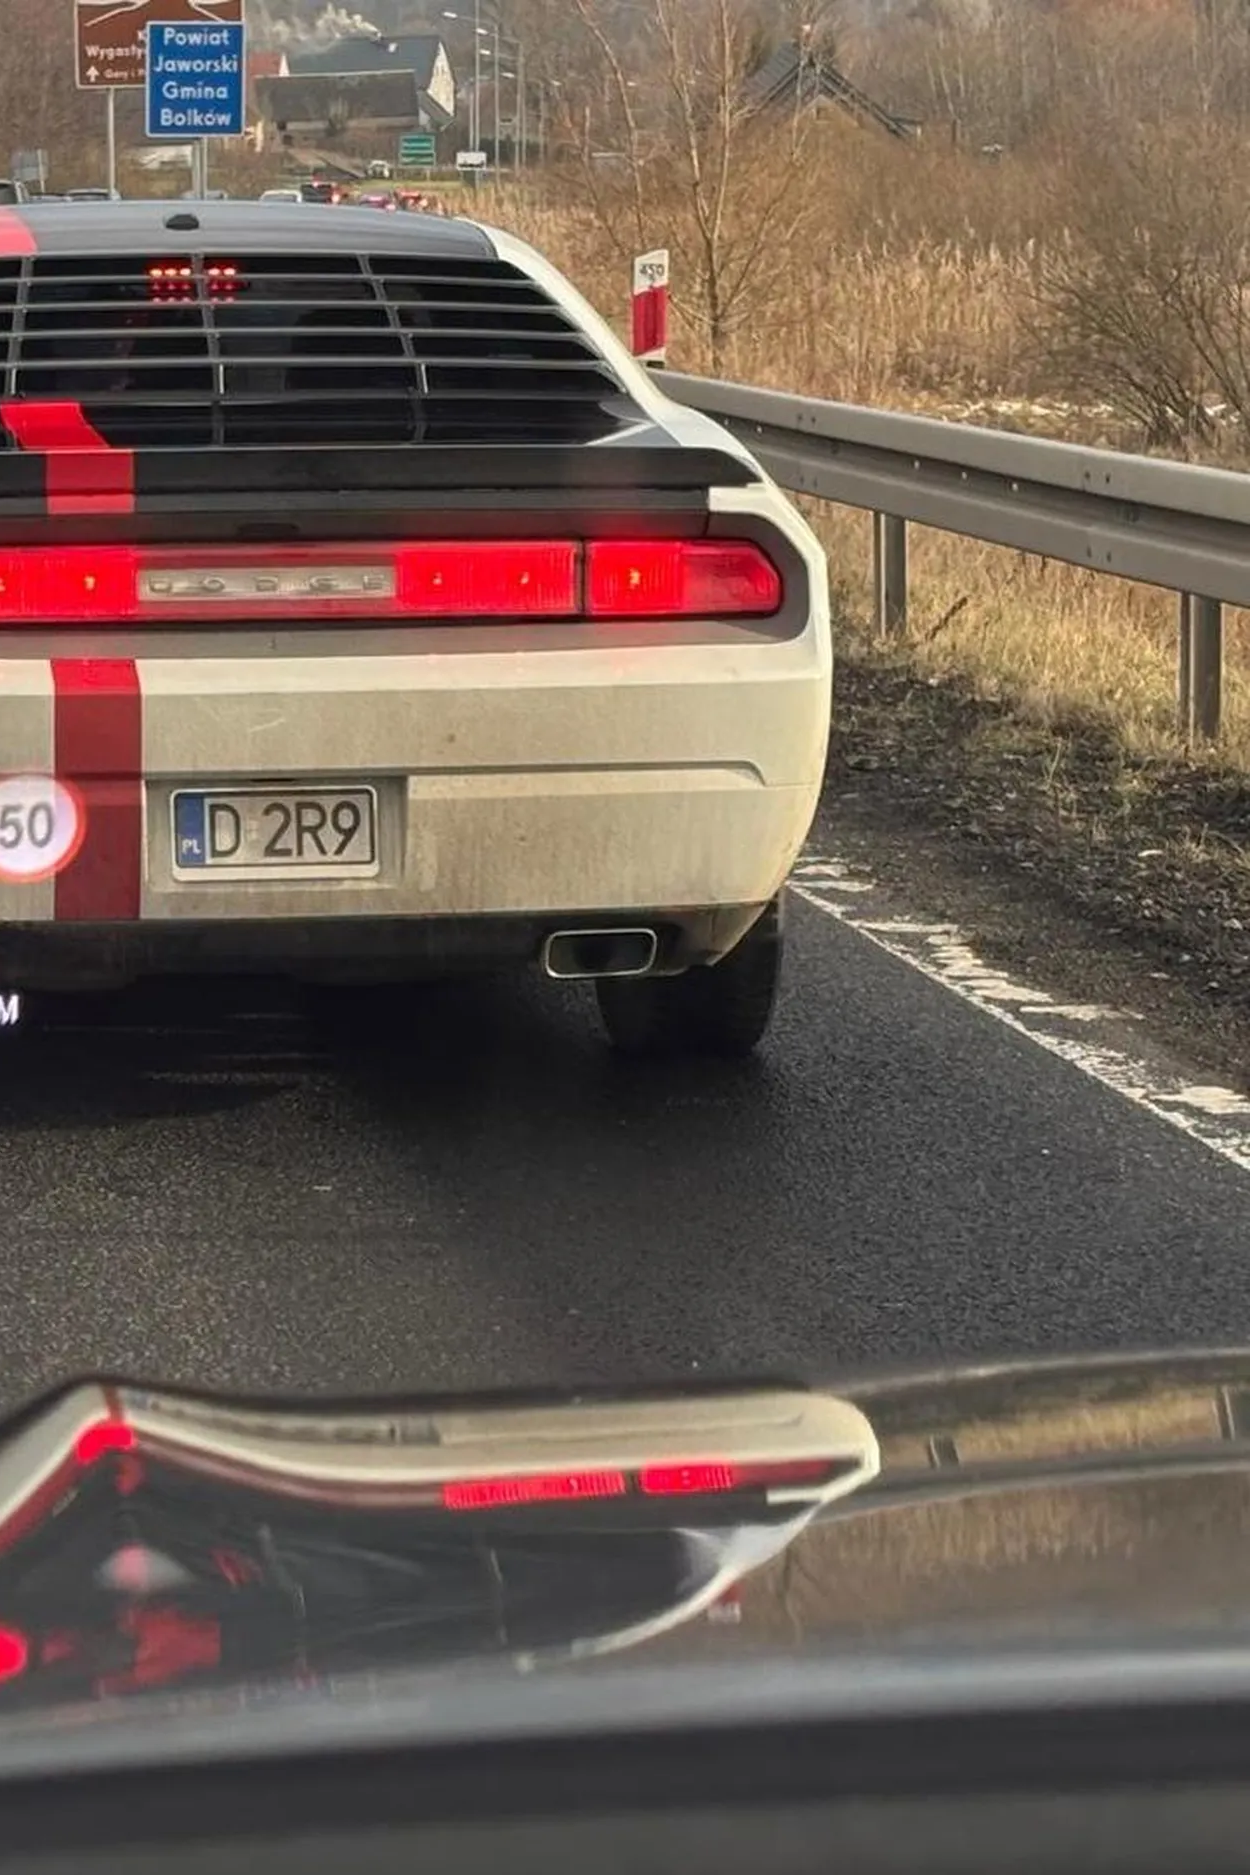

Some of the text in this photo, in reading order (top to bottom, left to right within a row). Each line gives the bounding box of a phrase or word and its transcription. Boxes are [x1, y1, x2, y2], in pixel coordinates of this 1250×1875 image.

[163, 27, 230, 46] Powiat
[84, 44, 146, 60] Wygasły
[153, 53, 239, 73] Jaworski
[161, 80, 229, 100] Gmina
[160, 105, 231, 126] Bolków
[208, 800, 362, 858] D 2R9
[181, 838, 201, 855] PL
